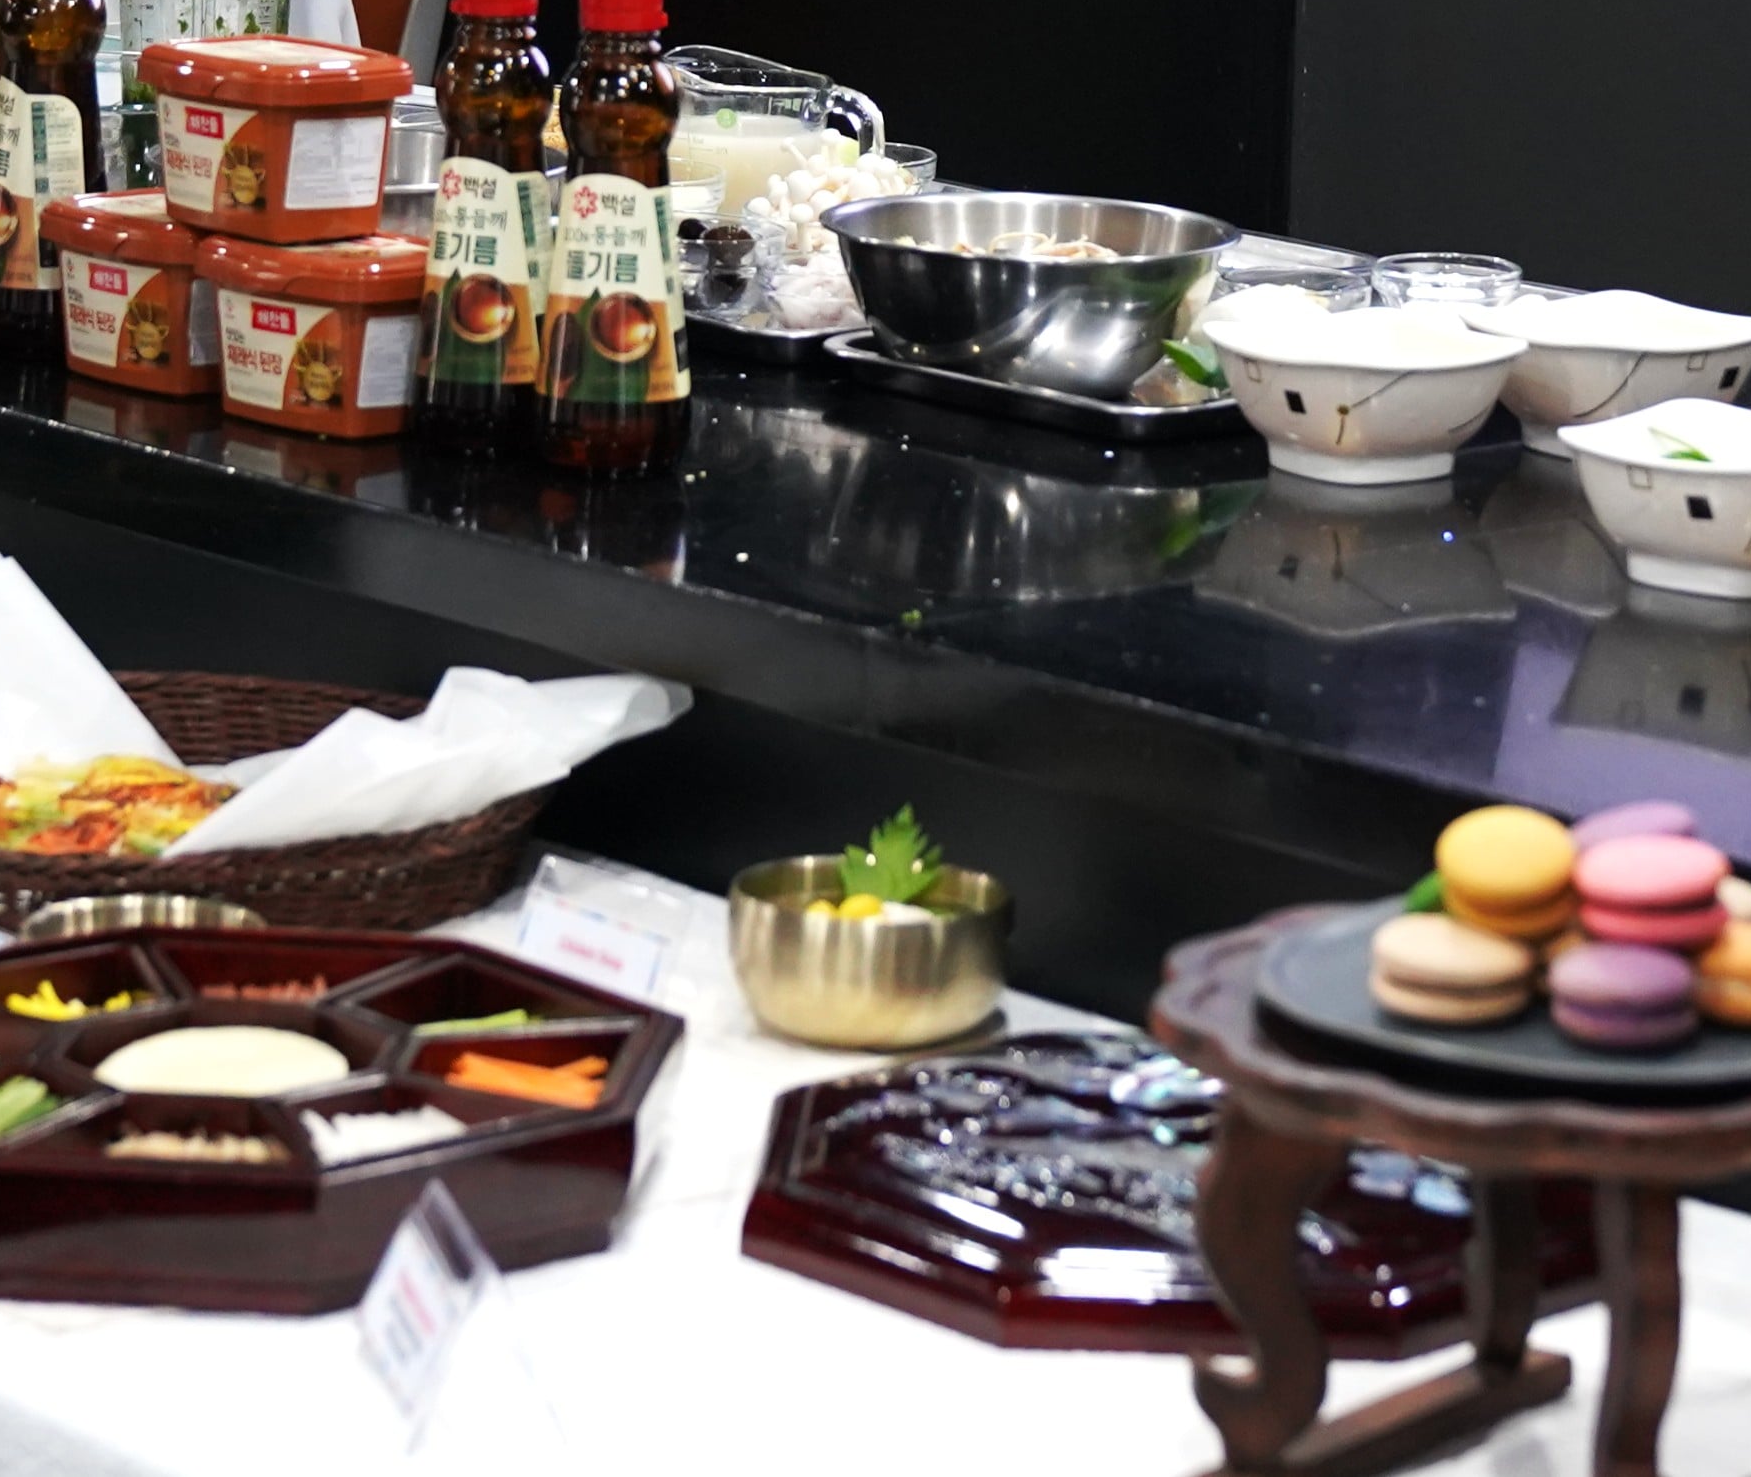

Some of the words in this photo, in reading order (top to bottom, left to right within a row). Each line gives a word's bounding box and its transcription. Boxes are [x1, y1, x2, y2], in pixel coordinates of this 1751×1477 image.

[463, 175, 498, 201] 백설
[600, 192, 637, 218] 백설
[433, 230, 498, 267] 들기름
[566, 248, 640, 285] 들기름
